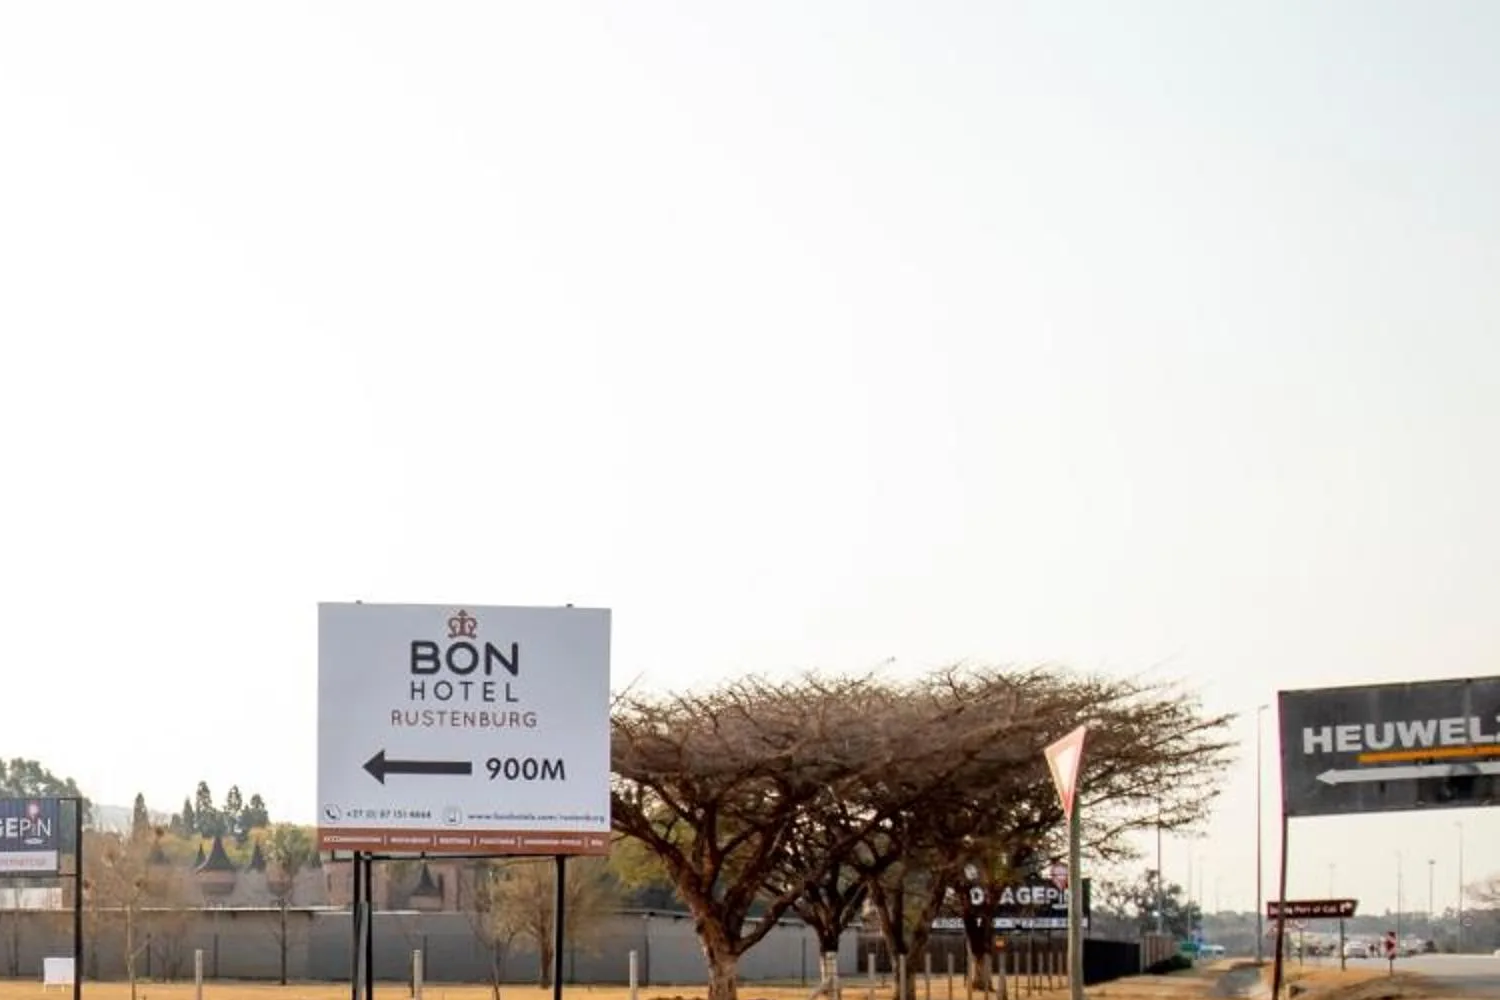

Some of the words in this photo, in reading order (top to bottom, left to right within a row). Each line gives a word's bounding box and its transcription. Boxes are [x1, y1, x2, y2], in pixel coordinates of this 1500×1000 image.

[410, 640, 519, 676] BON
[410, 680, 519, 702] HOTEL
[391, 709, 537, 728] RUSTENBURG
[1303, 716, 1500, 754] HEUWEL
[486, 757, 565, 781] 900M
